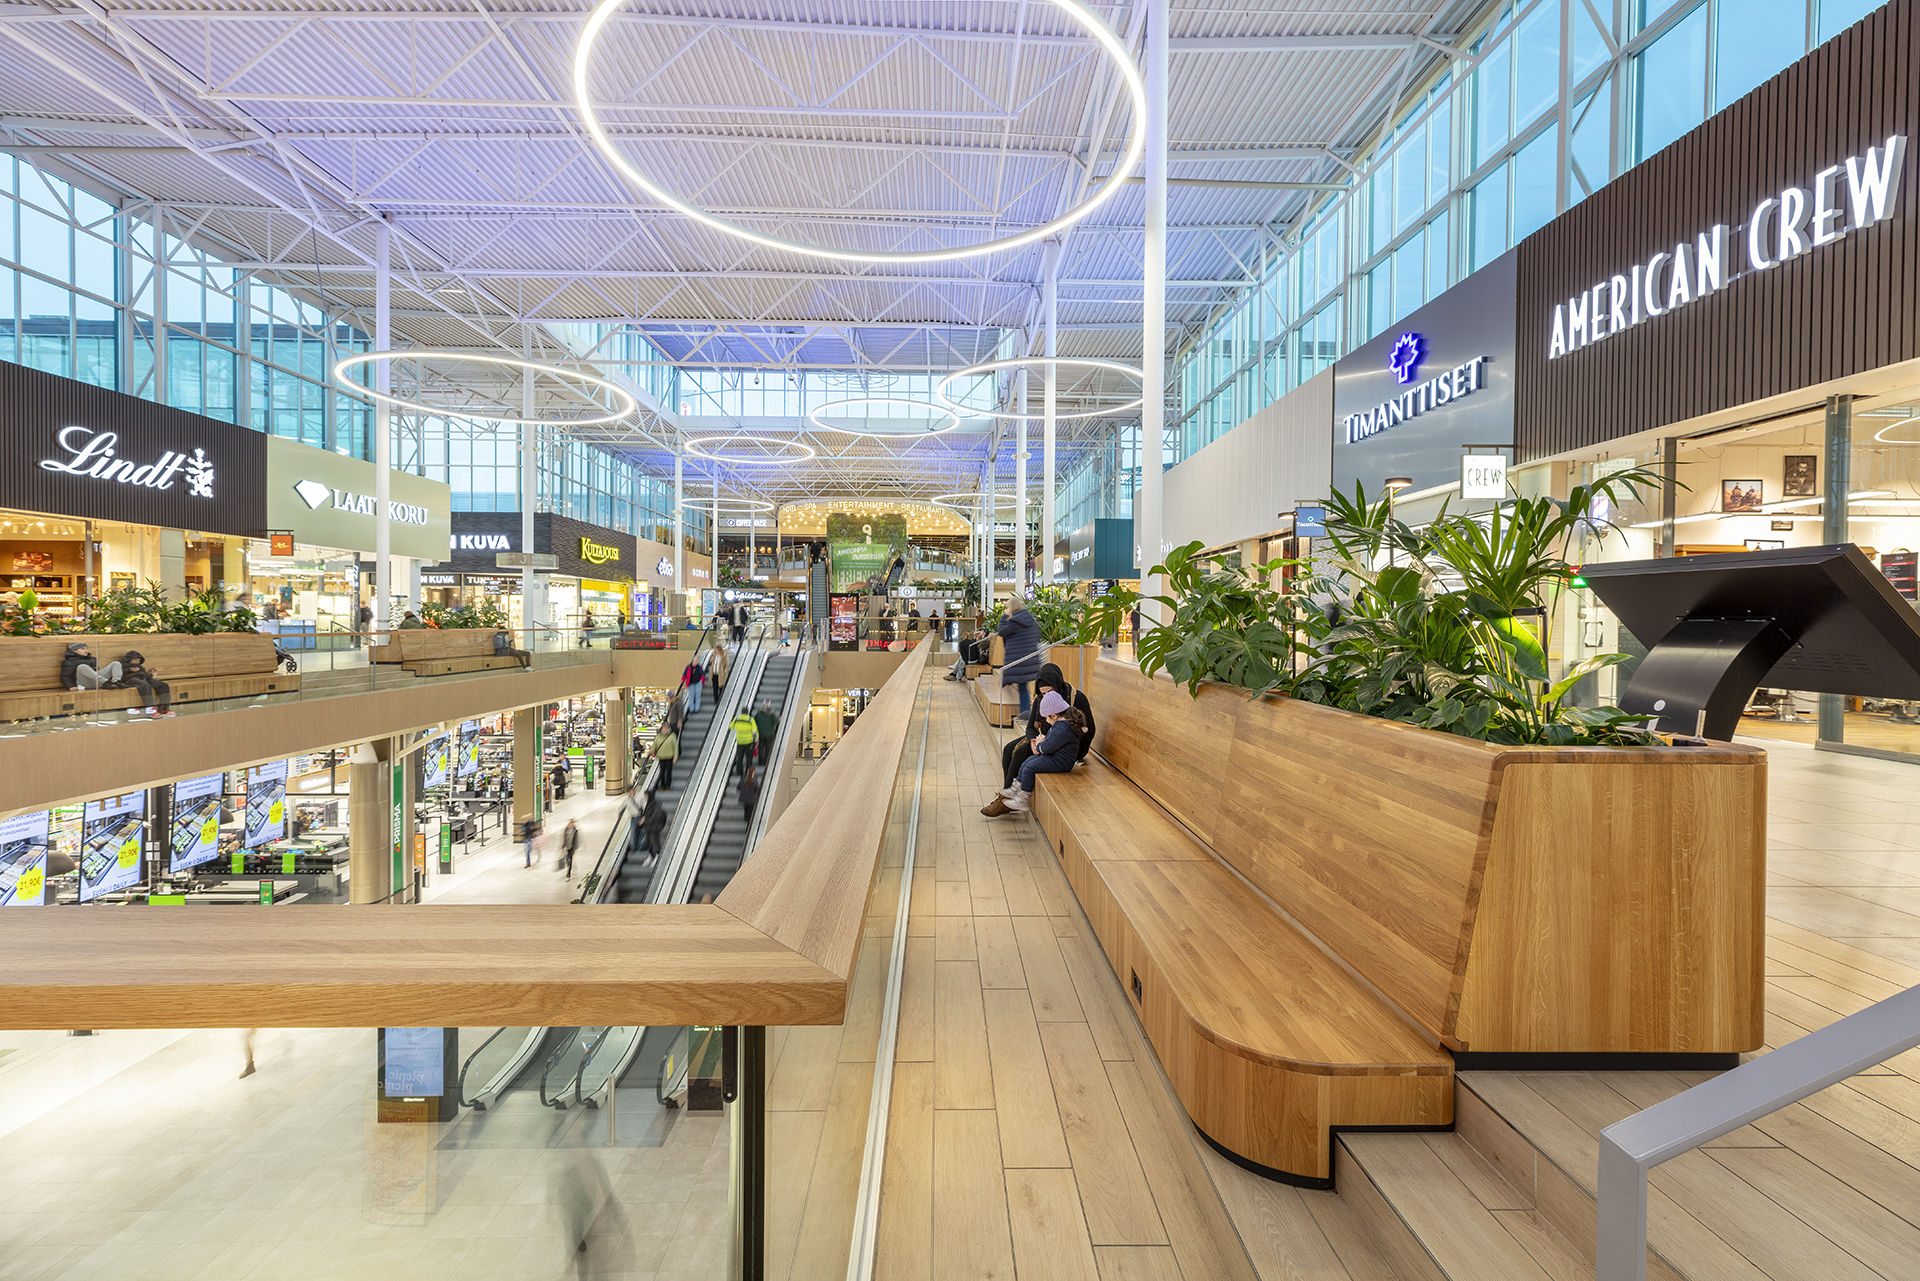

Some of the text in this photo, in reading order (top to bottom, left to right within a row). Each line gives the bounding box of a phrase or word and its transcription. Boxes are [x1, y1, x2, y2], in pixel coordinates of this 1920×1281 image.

[1549, 134, 1907, 360] AMERICAN CREW
[1343, 355, 1487, 445] TIMANTTISET
[40, 426, 187, 490] Lindt
[1467, 467, 1502, 486] CREW
[331, 488, 428, 526] LAATKORU
[804, 502, 817, 510] SPA
[828, 501, 894, 510] ENTERTAINMENT
[901, 502, 946, 515] RESTAURANTS
[460, 534, 510, 550] KUVA
[580, 536, 619, 564] KULTAJOUSI
[429, 575, 455, 584] KUVA
[92, 881, 128, 897] SUSHI DAILY
